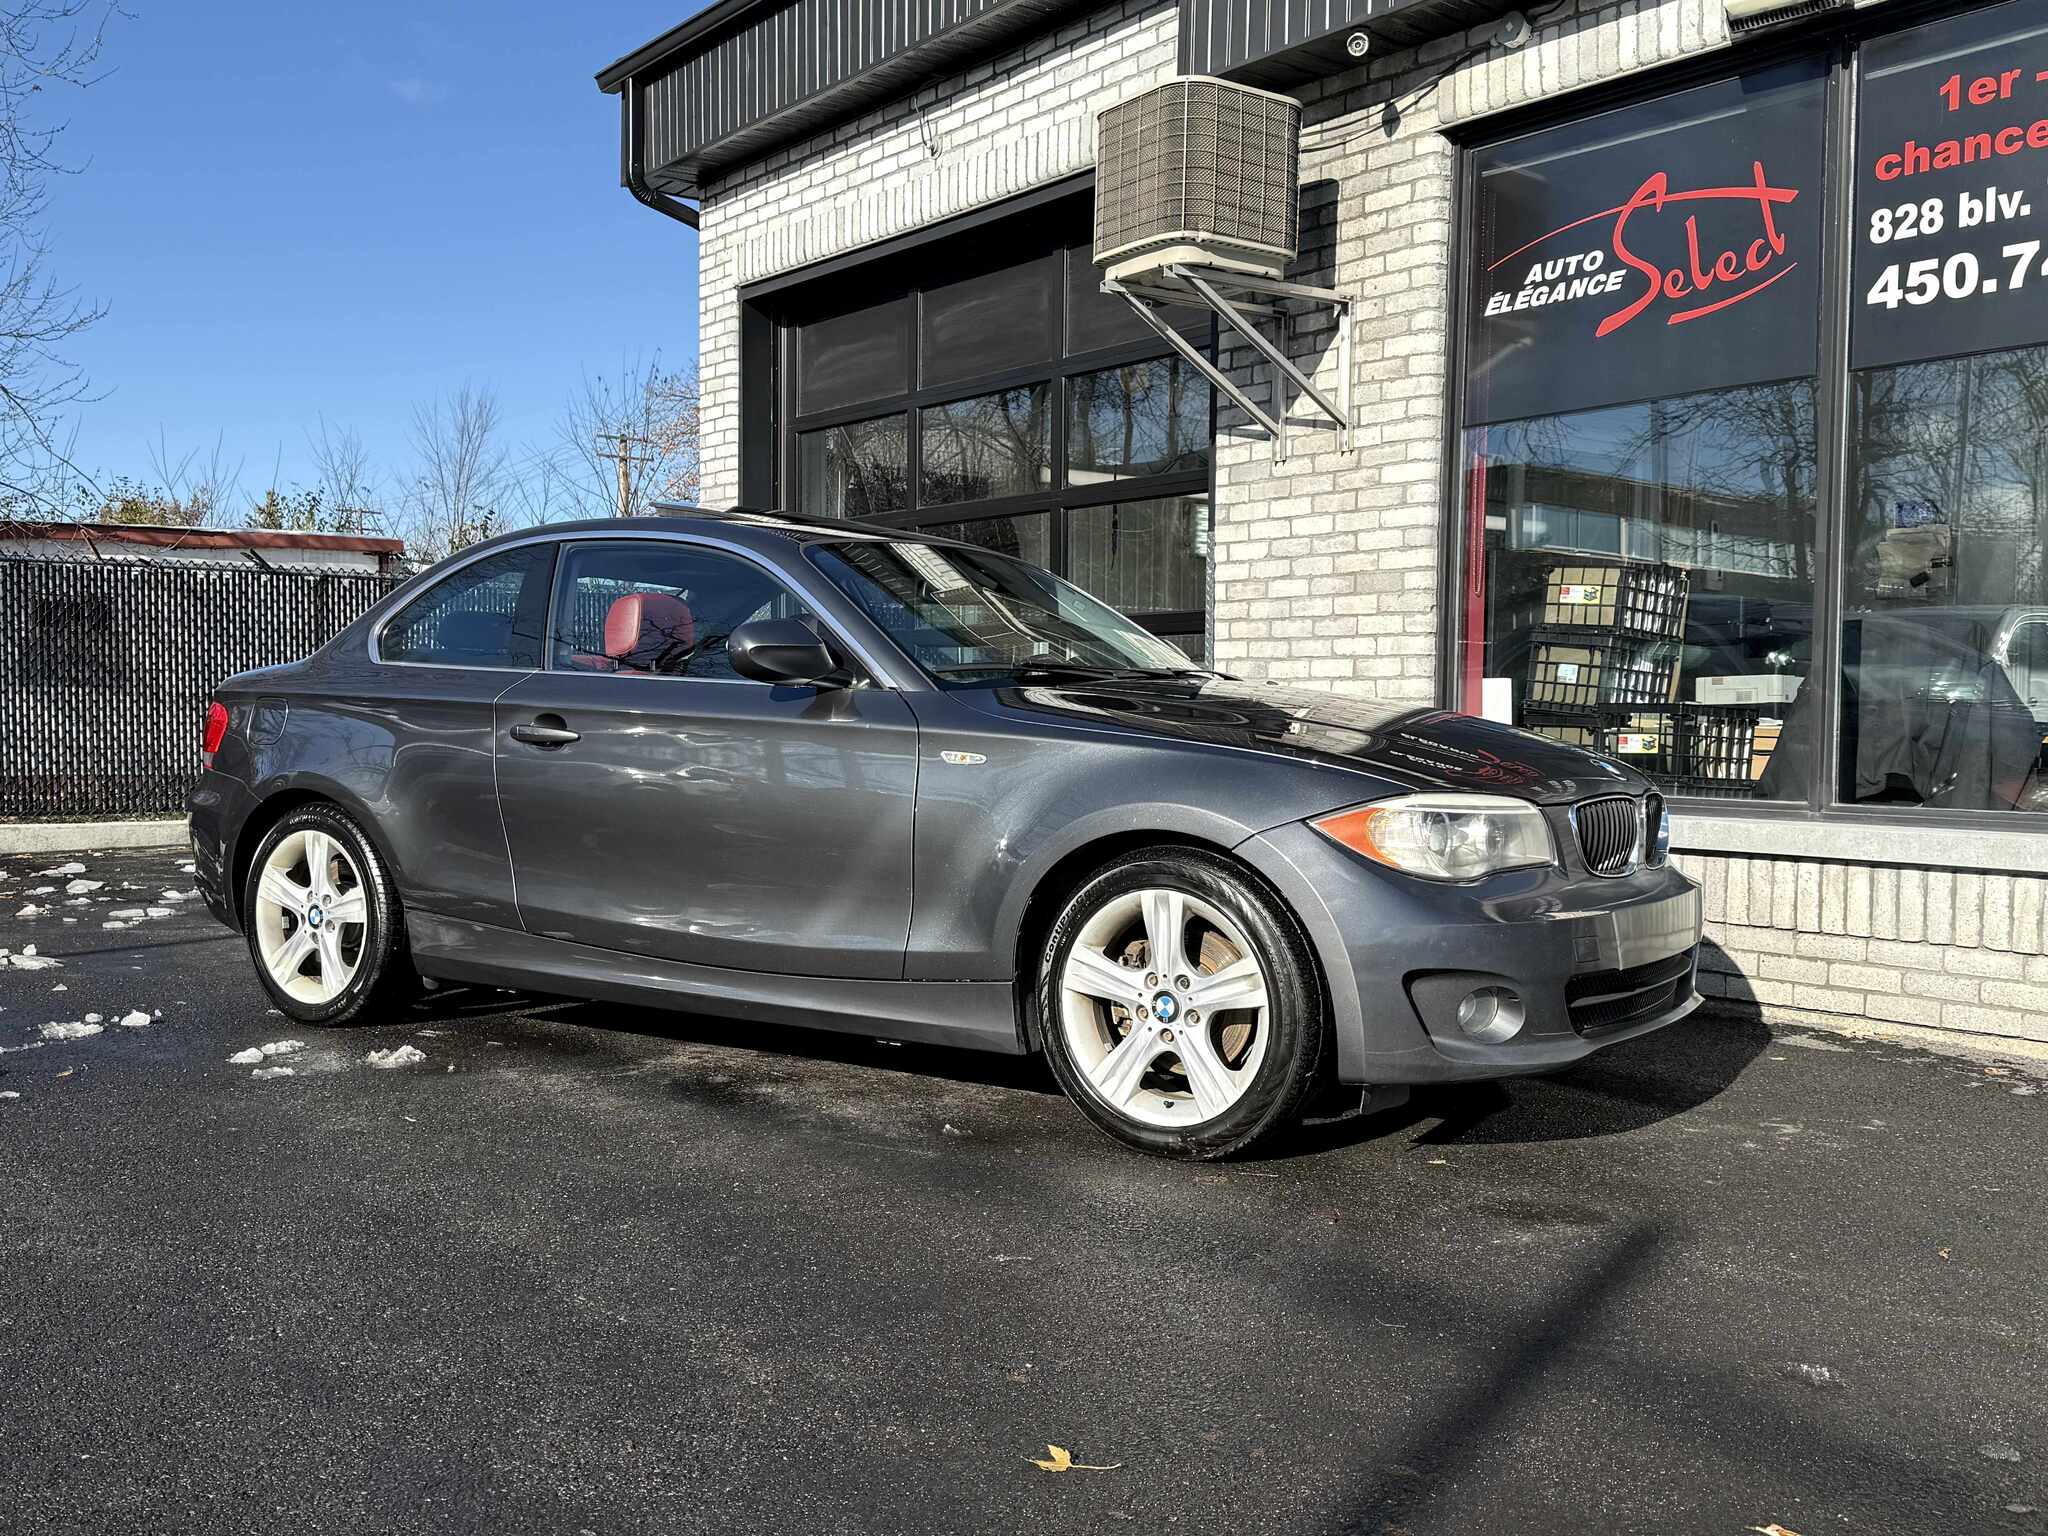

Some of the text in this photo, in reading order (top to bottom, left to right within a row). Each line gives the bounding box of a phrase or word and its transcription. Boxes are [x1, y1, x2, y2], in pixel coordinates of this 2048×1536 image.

[1939, 68, 2022, 112] 1er
[1875, 119, 2048, 181] chance
[1869, 186, 2031, 244] 828 blv.
[1525, 249, 1604, 285] AUTO
[1595, 160, 1799, 338] Select
[1866, 239, 2048, 310] 450.7
[1483, 268, 1627, 317] ÉLÉGANCE
